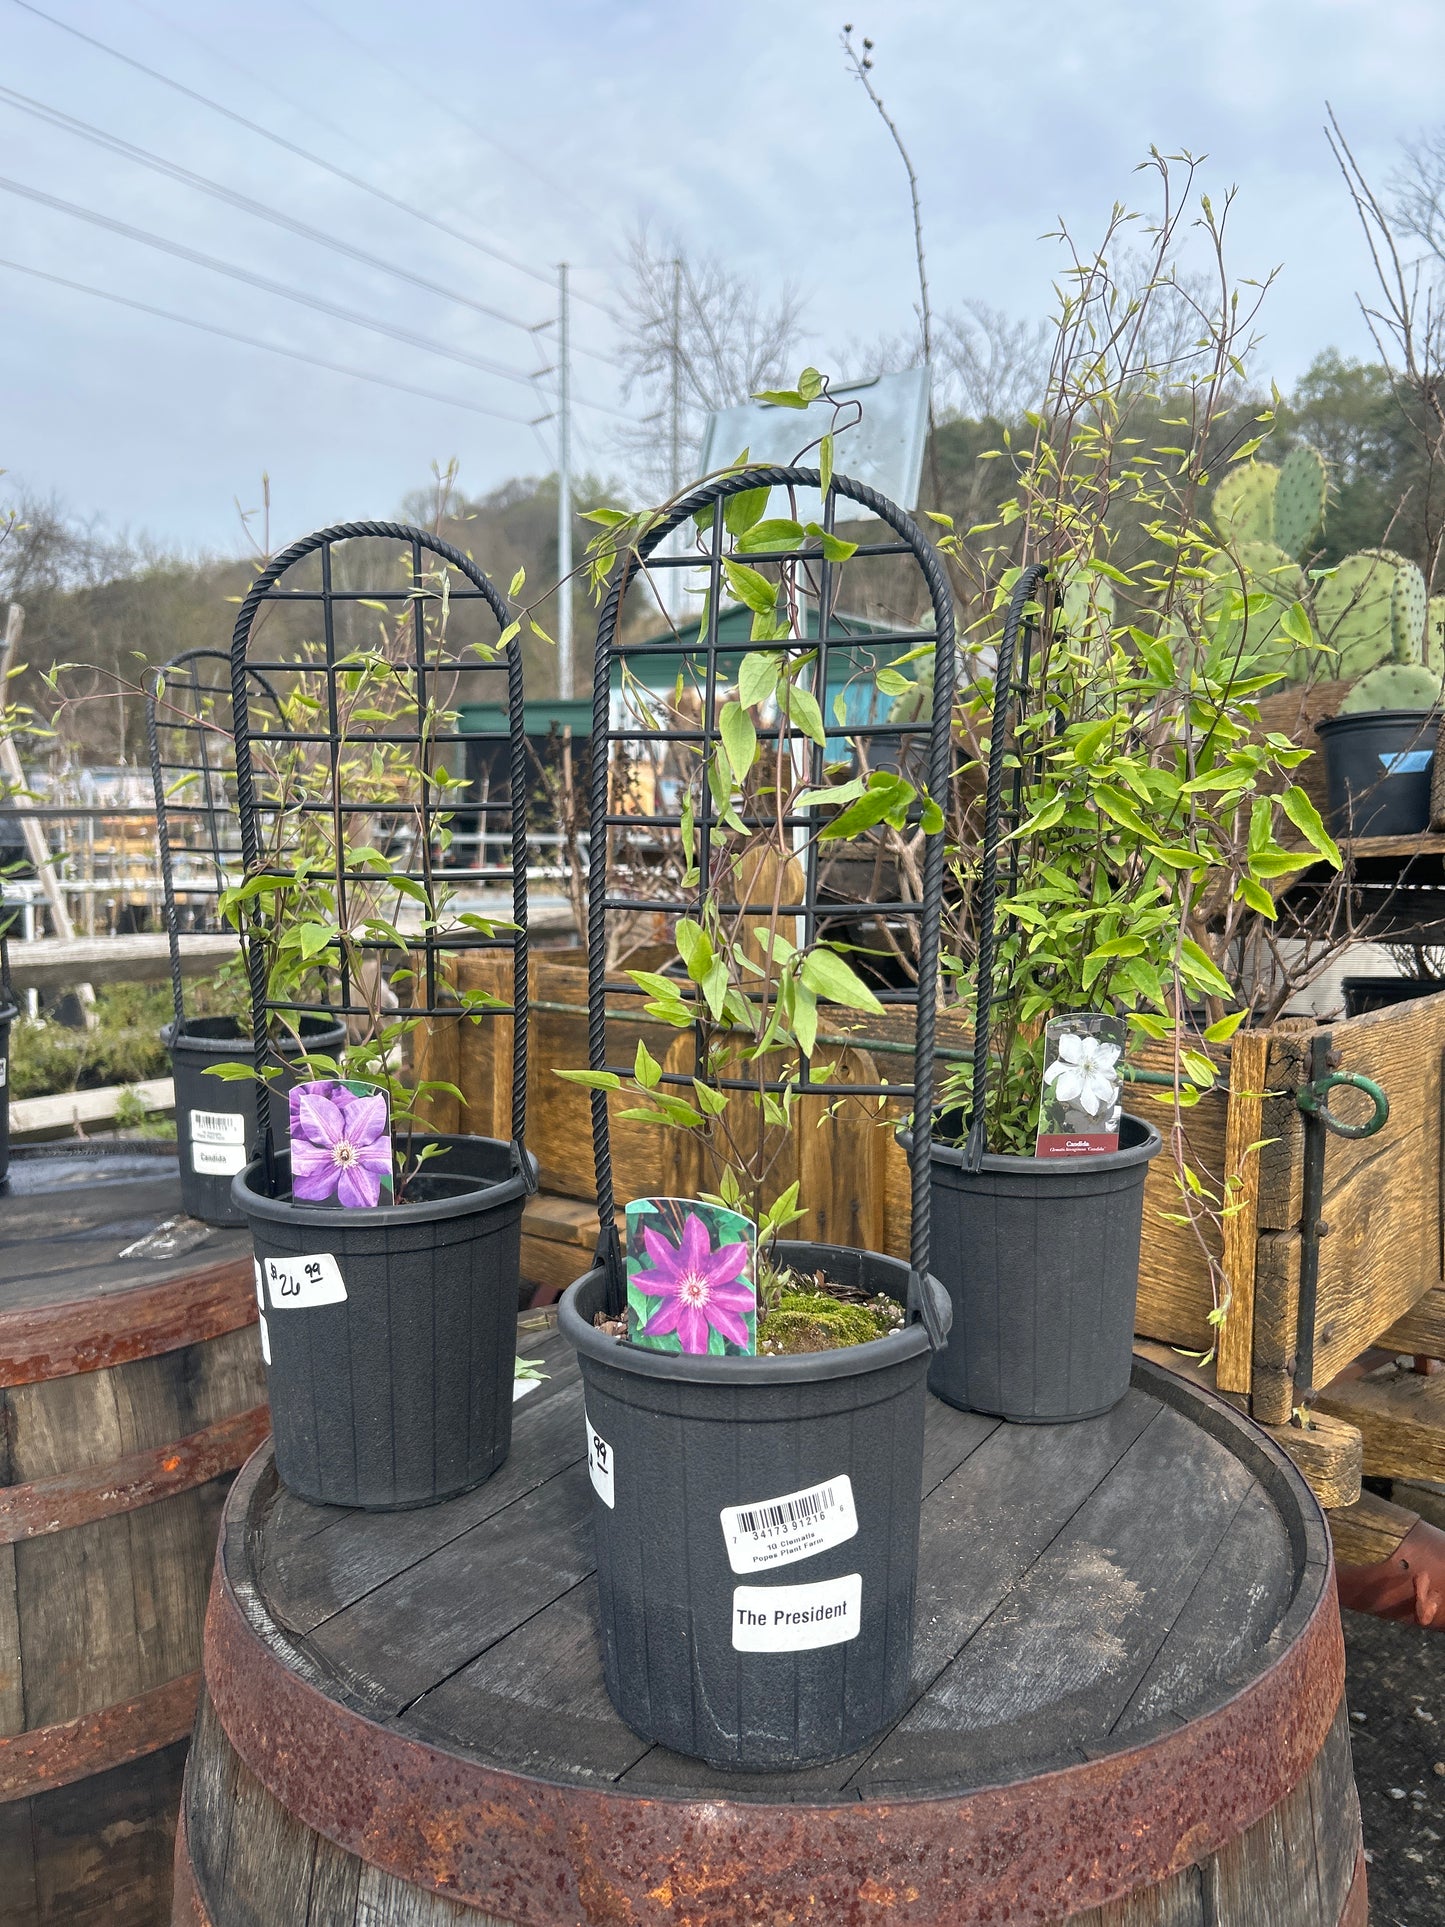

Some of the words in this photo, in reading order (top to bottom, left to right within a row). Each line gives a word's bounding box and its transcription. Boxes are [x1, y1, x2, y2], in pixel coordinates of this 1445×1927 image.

[752, 1524, 788, 1541] 34173
[780, 1533, 815, 1548] Clematis
[752, 1553, 778, 1563] Popes
[780, 1545, 802, 1556] Plant
[803, 1538, 824, 1549] Farm
[737, 1609, 767, 1625] The
[774, 1601, 847, 1625] President
